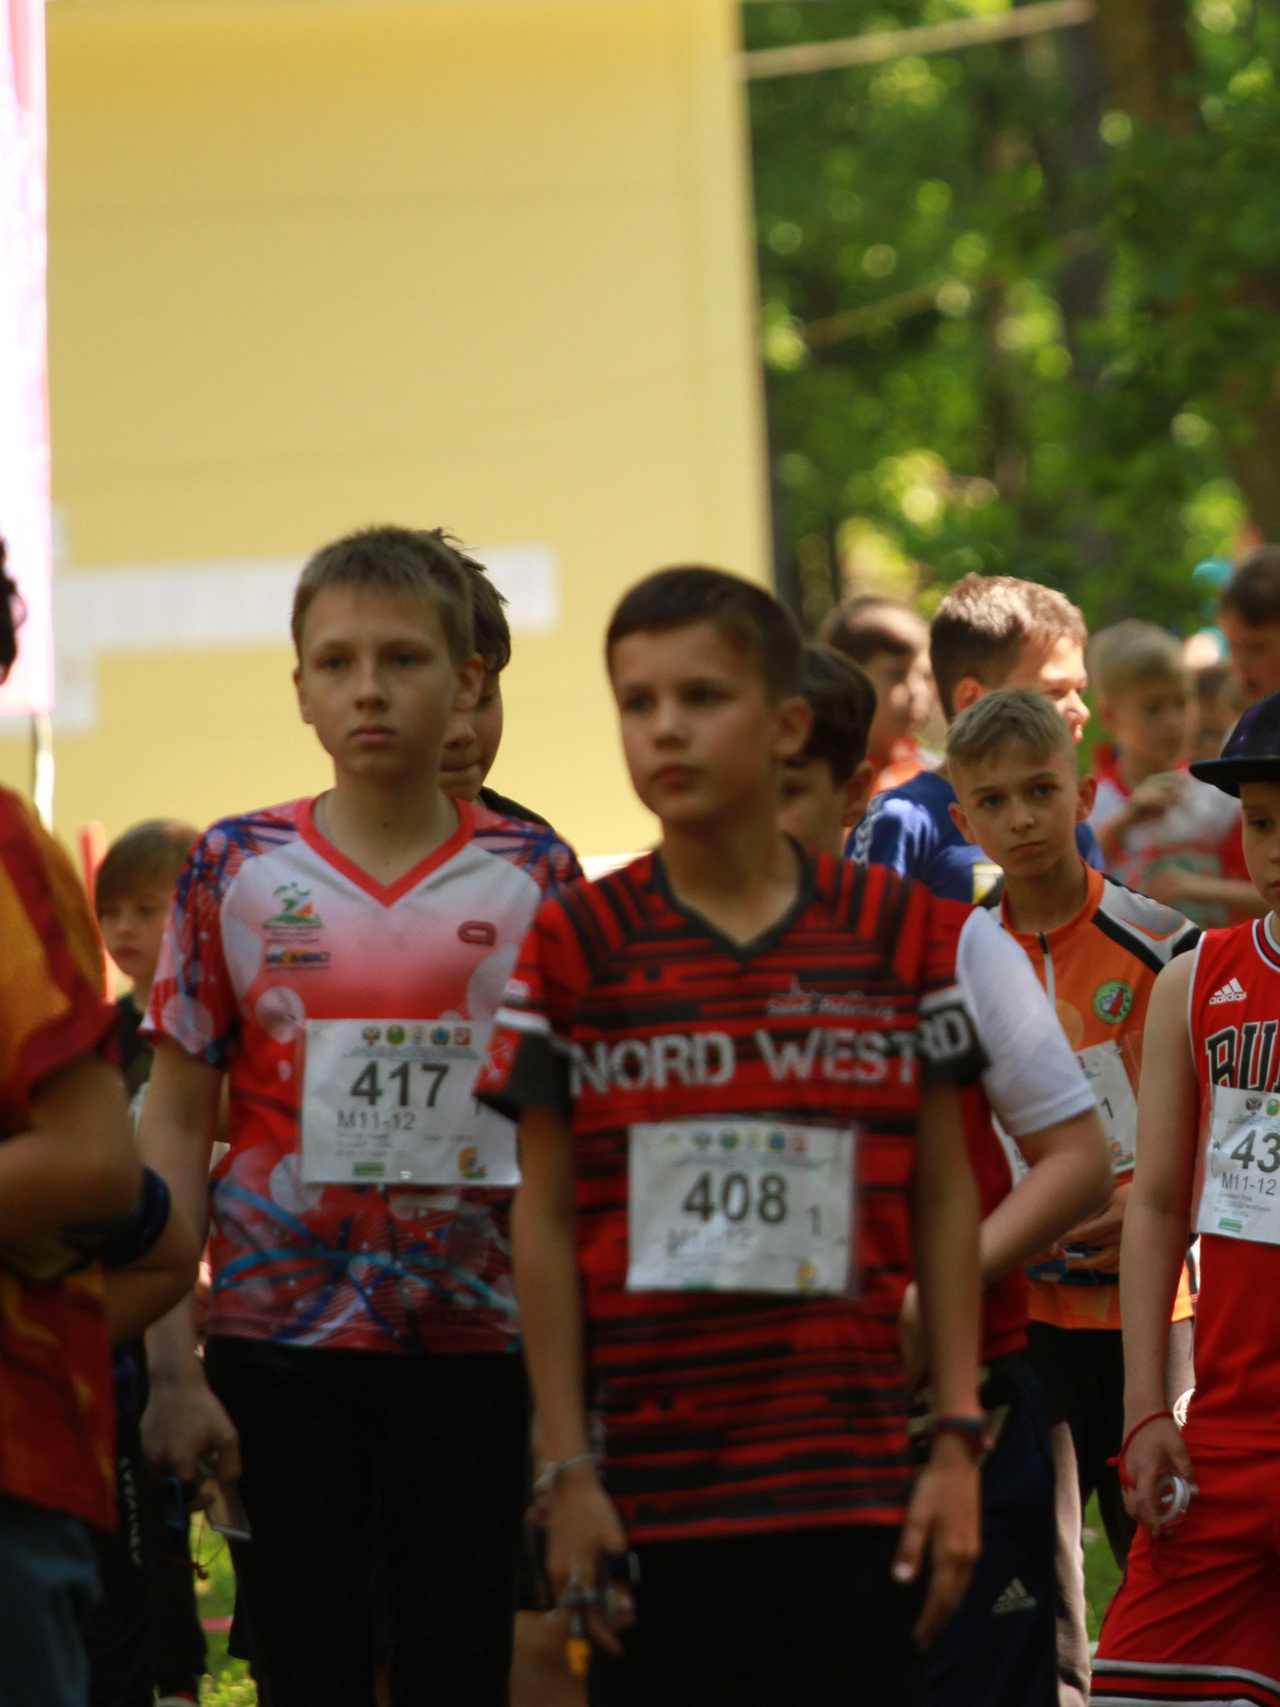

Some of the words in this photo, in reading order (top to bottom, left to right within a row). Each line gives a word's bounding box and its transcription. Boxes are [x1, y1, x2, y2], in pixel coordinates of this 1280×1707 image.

[1209, 992, 1247, 1005] adidas
[570, 1031, 736, 1096] NORD
[755, 1027, 915, 1085] WEST
[351, 1060, 448, 1107] 417
[336, 1110, 416, 1130] M11-12
[682, 1171, 788, 1224] 408
[1221, 1172, 1277, 1196] M11-12
[809, 1202, 822, 1236] 1
